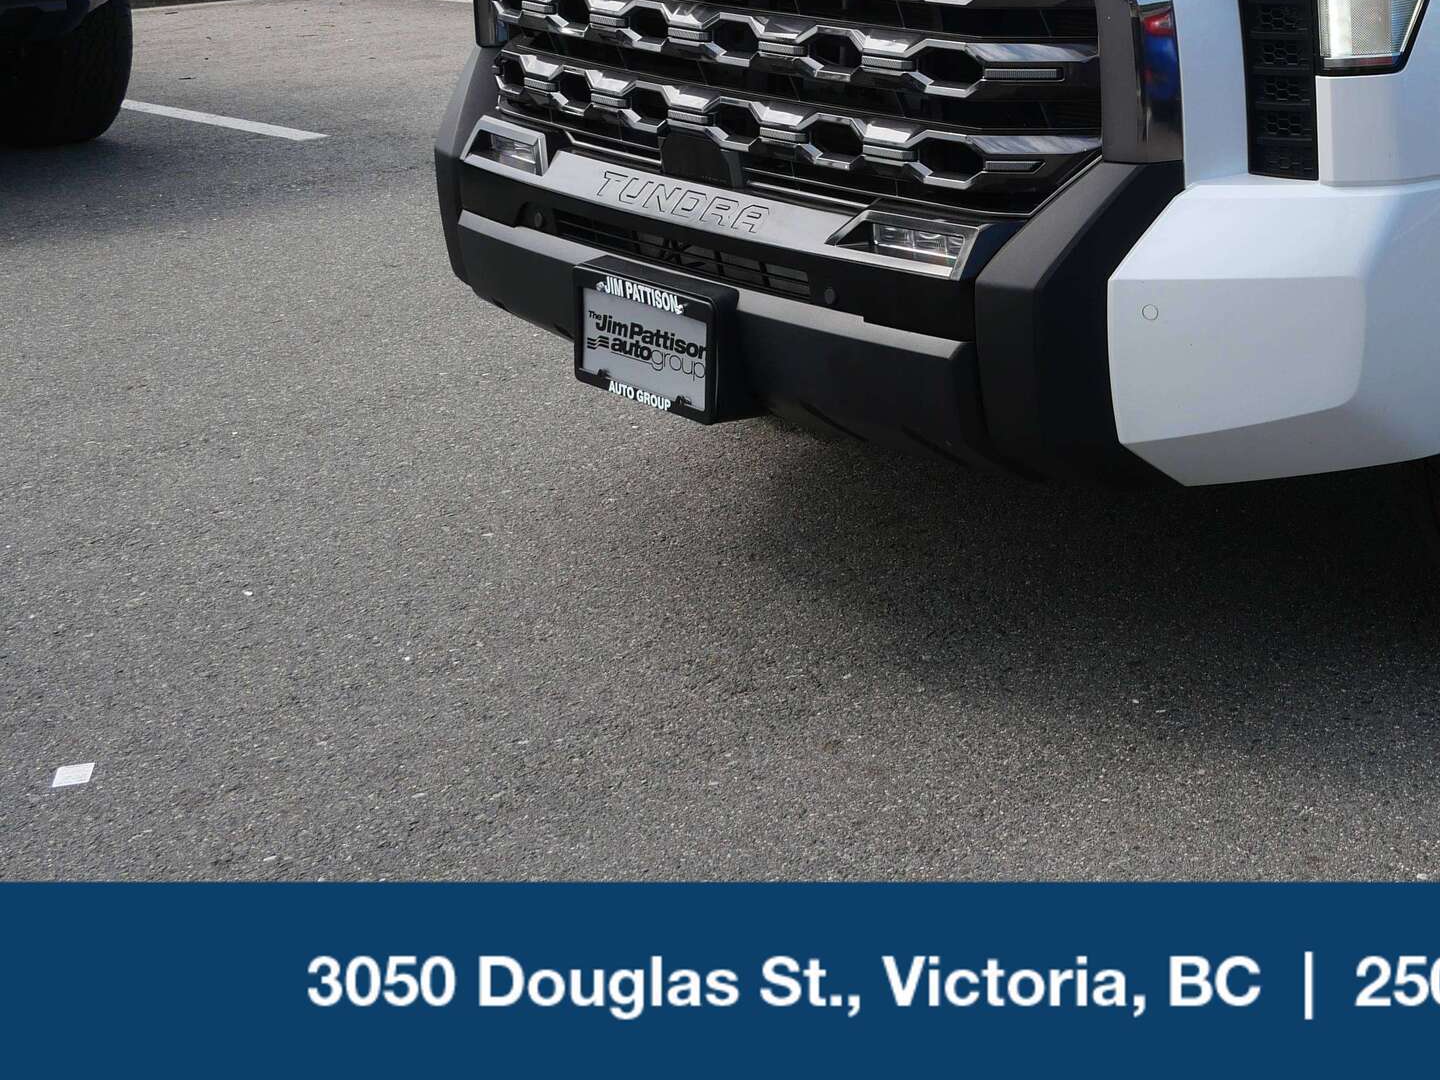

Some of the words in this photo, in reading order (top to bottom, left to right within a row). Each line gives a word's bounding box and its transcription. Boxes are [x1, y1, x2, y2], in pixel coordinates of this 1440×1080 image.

[597, 170, 770, 234] TUNDRA
[605, 276, 624, 298] JIM
[626, 282, 679, 312] PATTISON
[608, 380, 635, 399] AUTO
[636, 390, 672, 411] GROUP
